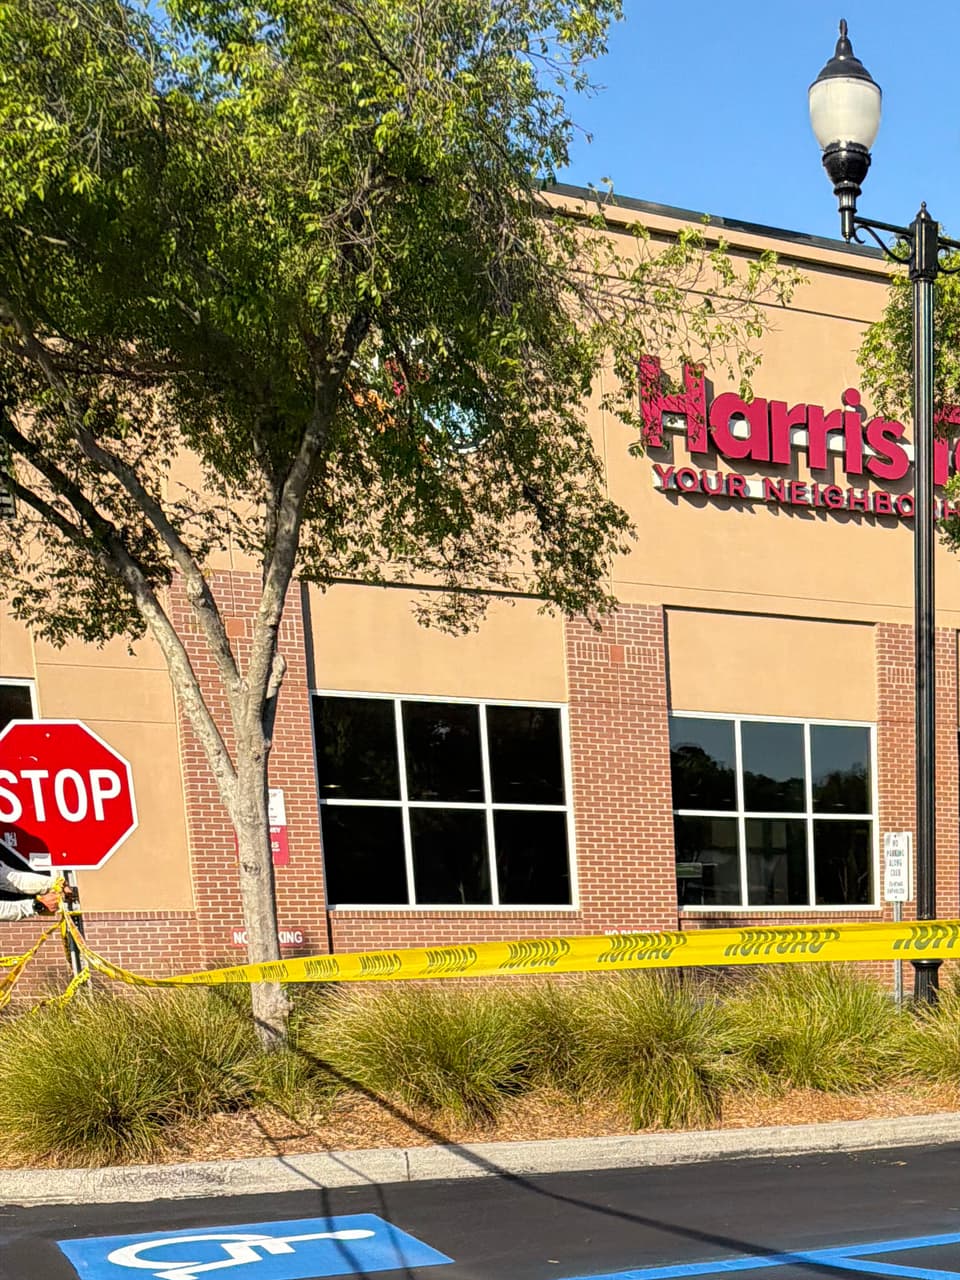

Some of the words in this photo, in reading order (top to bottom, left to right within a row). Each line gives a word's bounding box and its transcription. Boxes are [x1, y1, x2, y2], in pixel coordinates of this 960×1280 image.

[640, 354, 910, 481] Harris
[653, 463, 748, 499] YOUR
[0, 769, 121, 823] STOP
[278, 931, 303, 944] KING
